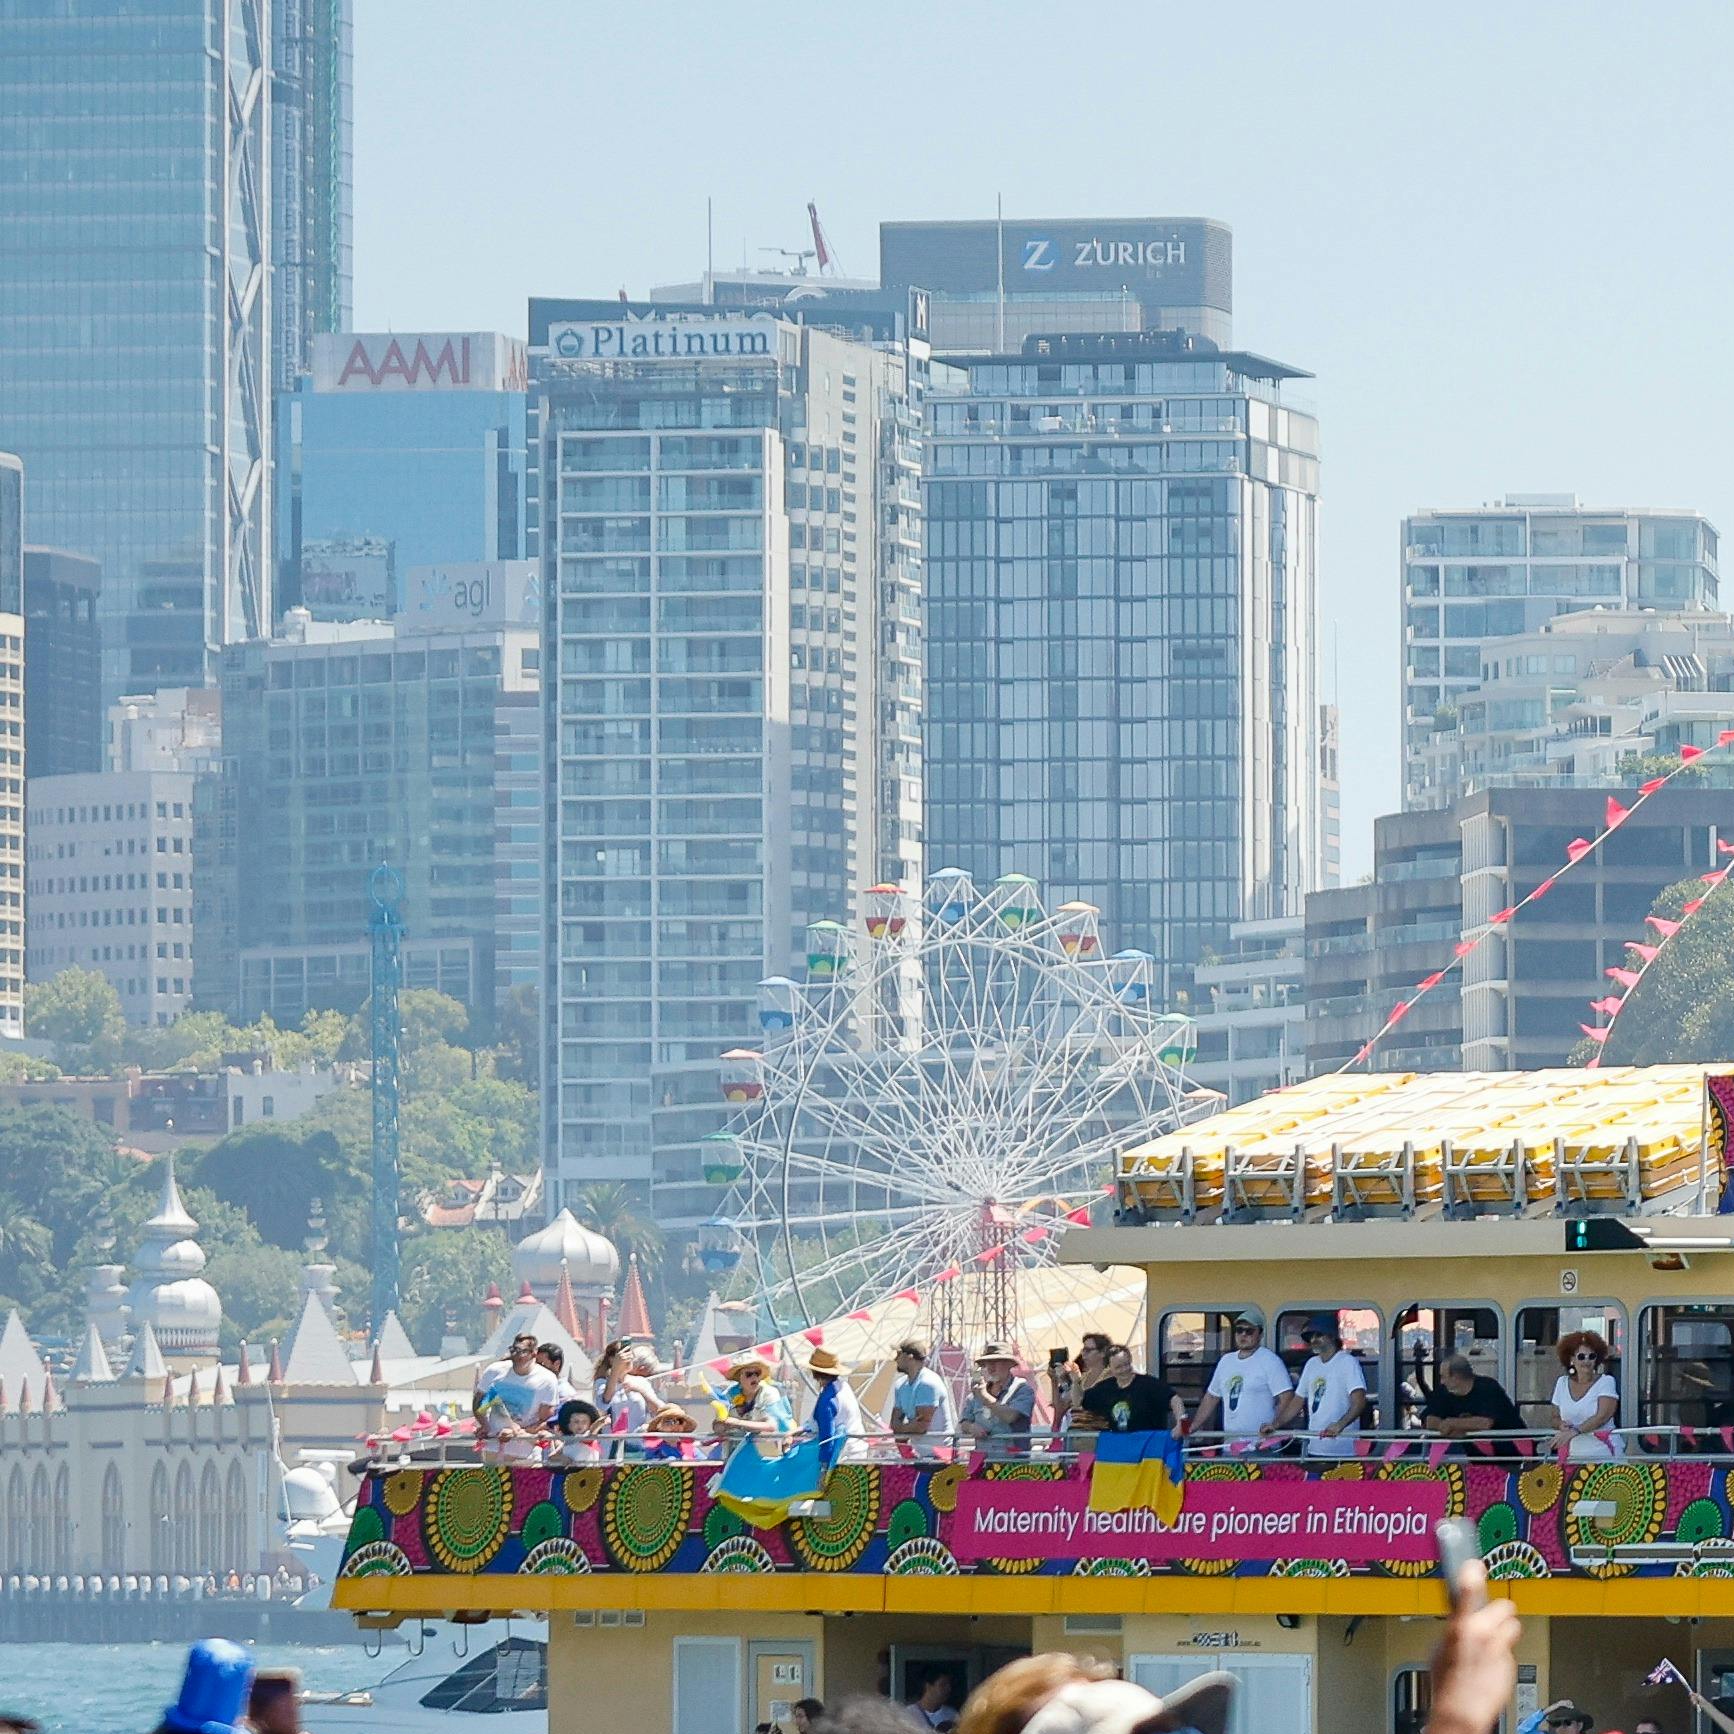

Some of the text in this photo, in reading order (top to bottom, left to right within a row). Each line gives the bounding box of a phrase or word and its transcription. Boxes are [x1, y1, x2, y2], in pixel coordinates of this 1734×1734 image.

[1074, 240, 1186, 266] ZURICH
[591, 326, 770, 357] Platinum
[338, 337, 470, 386] AAMI
[454, 569, 491, 616] agl
[973, 1505, 1079, 1542] Maternity
[1210, 1506, 1301, 1542] pioneer
[1306, 1506, 1327, 1533] in
[1332, 1506, 1428, 1542] Ethiopia
